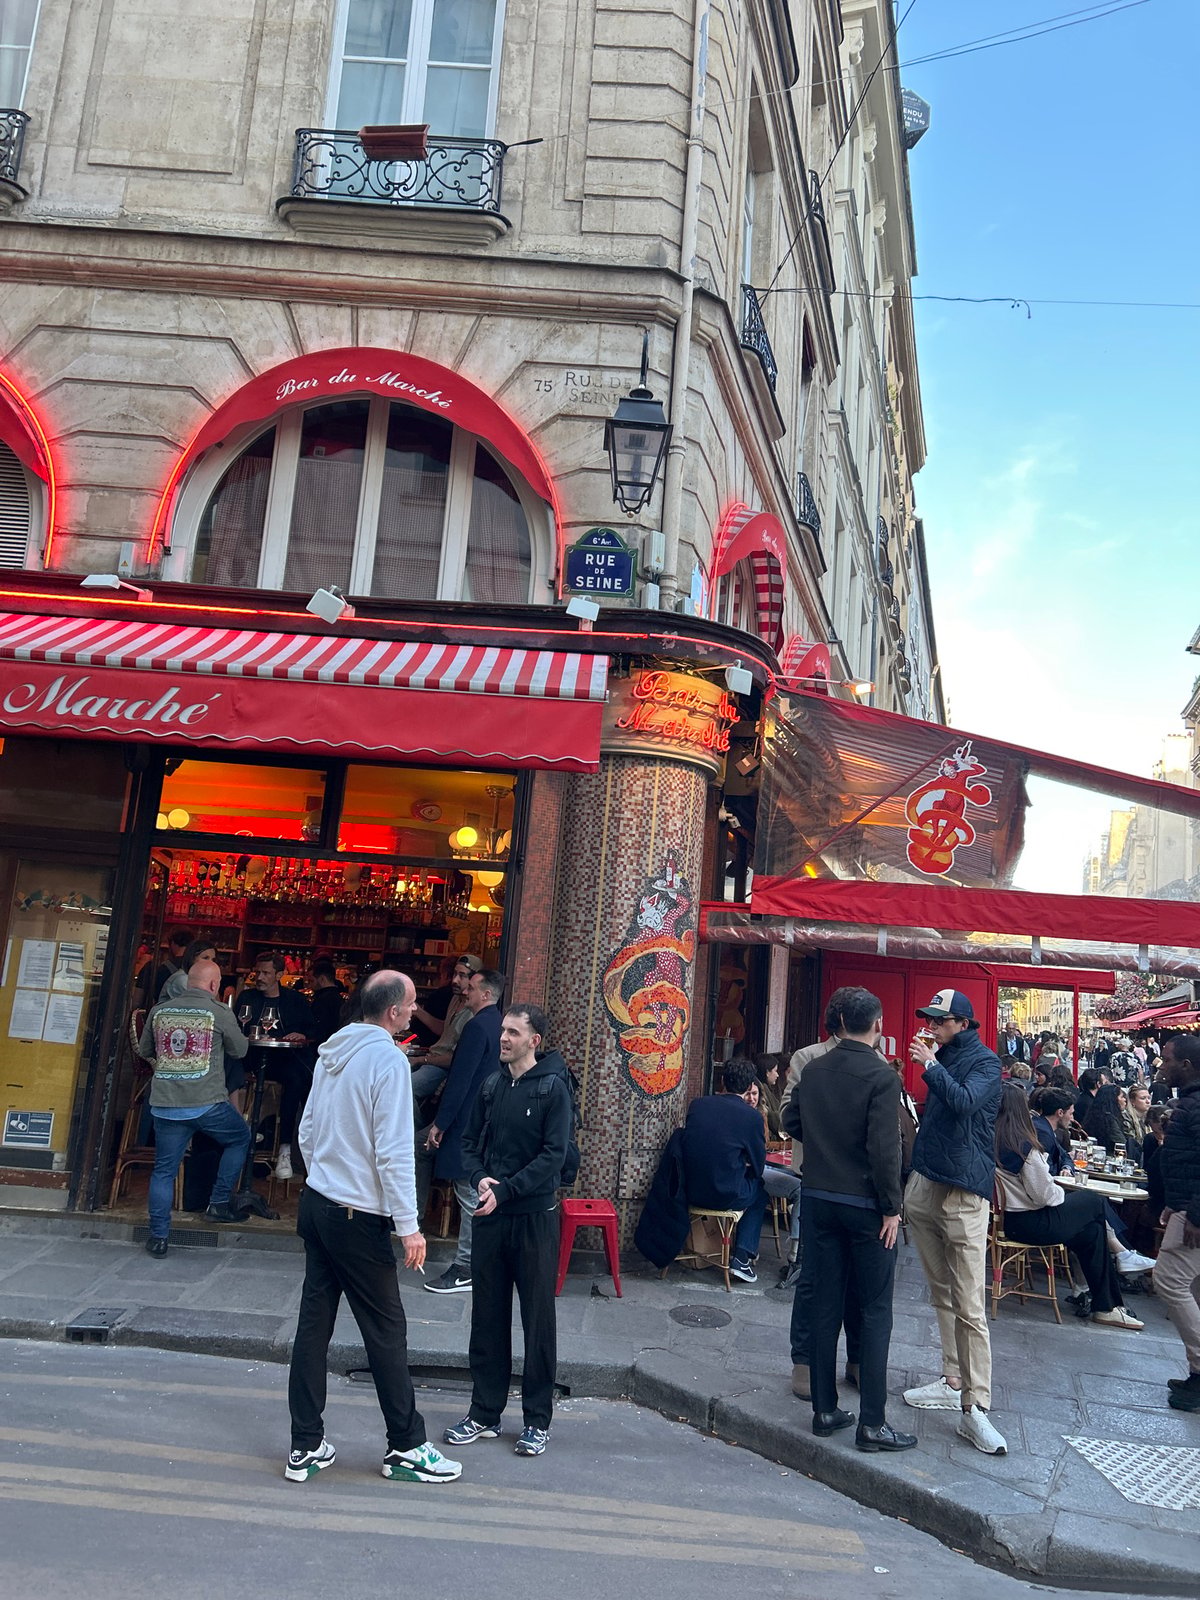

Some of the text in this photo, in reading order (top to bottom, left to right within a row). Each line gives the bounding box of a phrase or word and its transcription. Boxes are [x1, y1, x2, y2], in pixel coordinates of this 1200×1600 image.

[903, 107, 923, 117] ENDU
[276, 368, 452, 409] Bar du Marché
[534, 380, 553, 392] 75
[585, 553, 616, 567] RUE
[594, 567, 605, 575] DE
[575, 575, 623, 590] SEINE
[3, 674, 223, 725] Marché
[632, 670, 741, 723] Bar du
[617, 703, 731, 752] Marché
